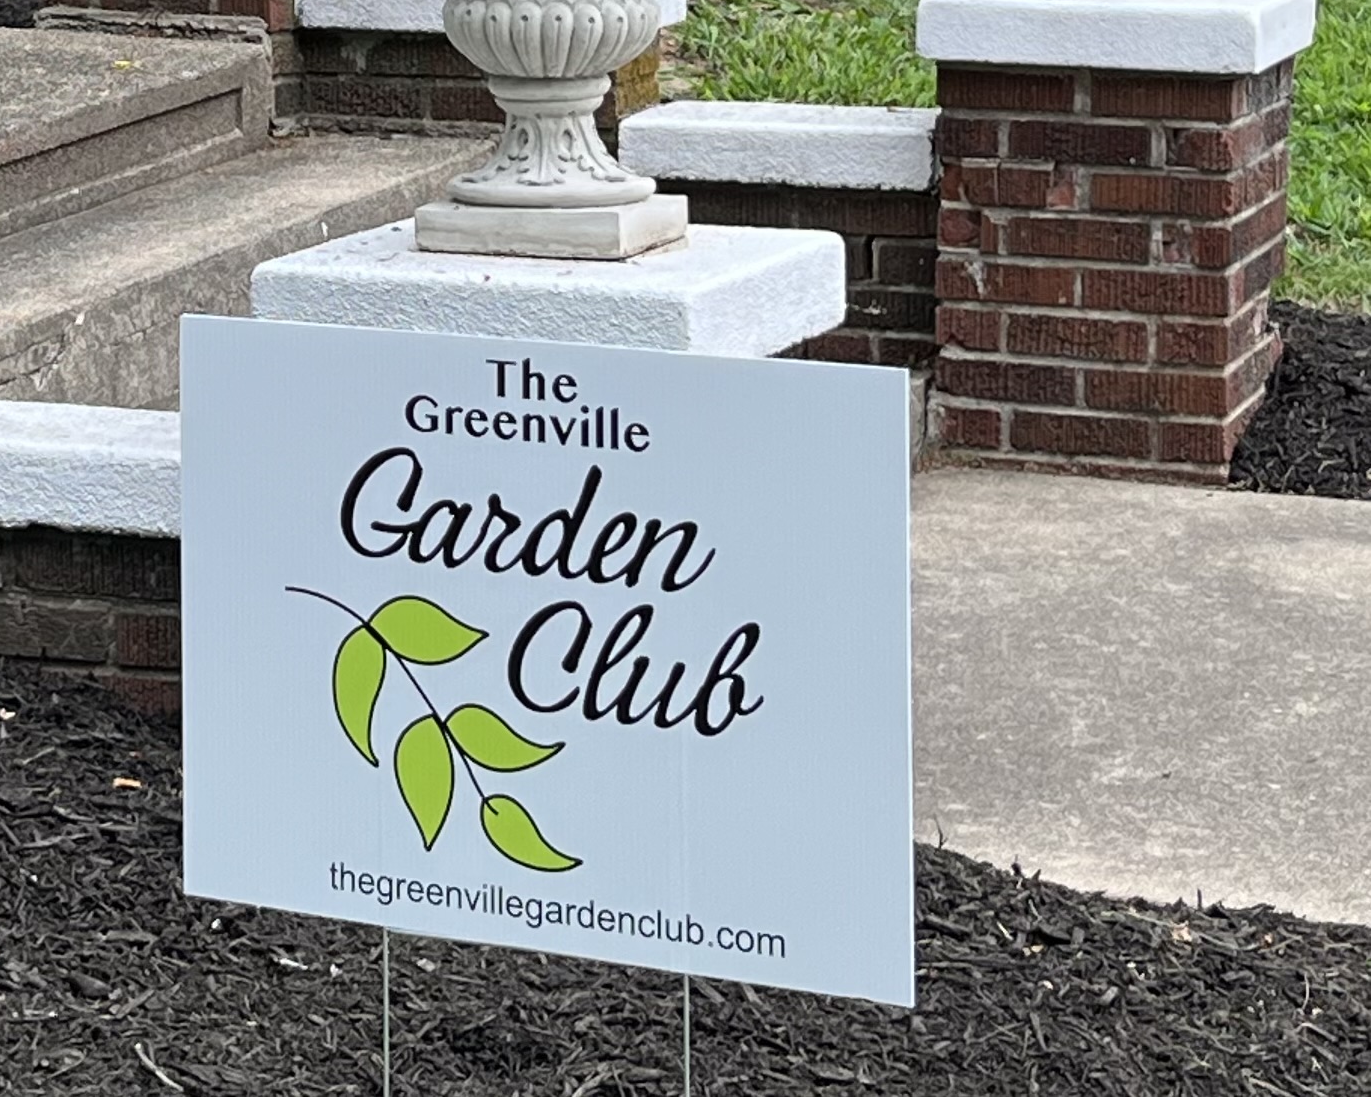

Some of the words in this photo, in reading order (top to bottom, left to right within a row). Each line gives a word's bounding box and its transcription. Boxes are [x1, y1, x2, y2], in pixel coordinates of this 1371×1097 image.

[405, 395, 651, 453] Greenville
[485, 358, 578, 404] The
[340, 447, 716, 593] Garden
[507, 600, 764, 737] Club
[329, 862, 786, 959] thegreenvillegardenclub.com
